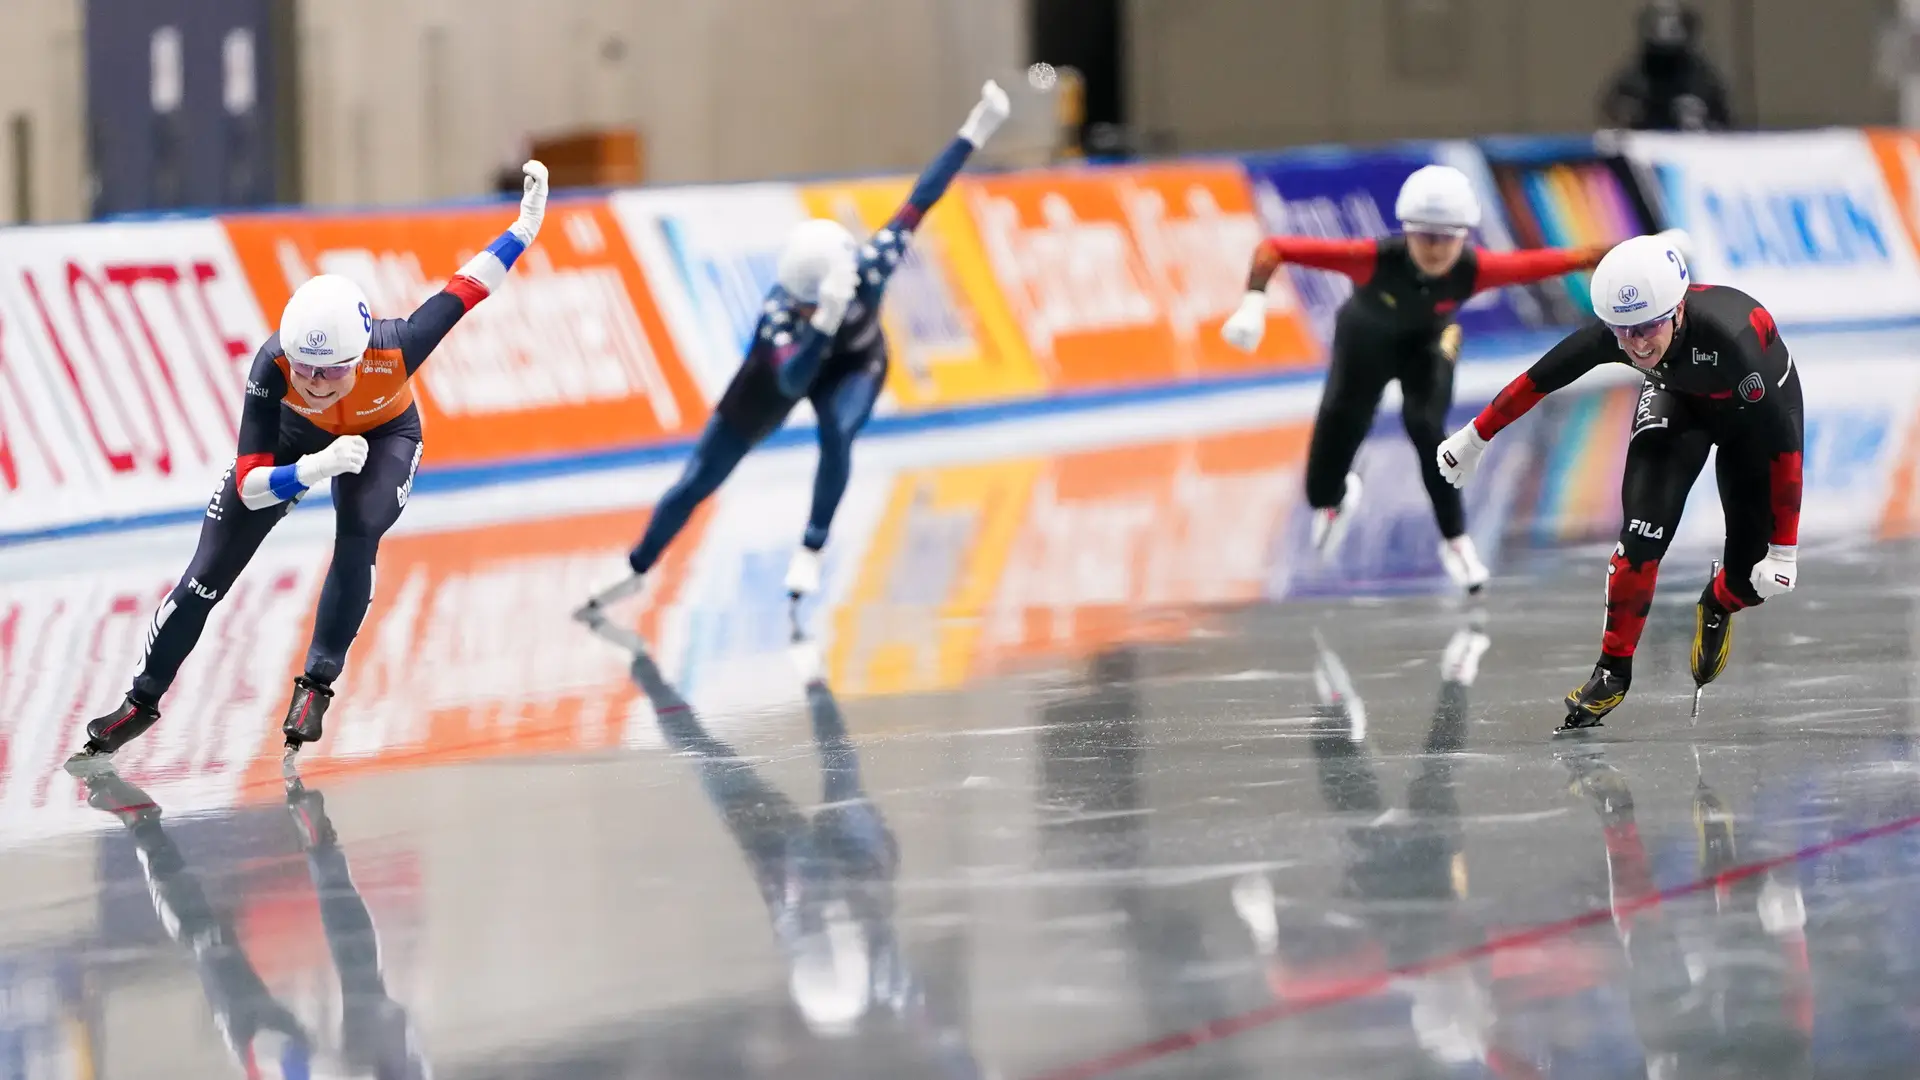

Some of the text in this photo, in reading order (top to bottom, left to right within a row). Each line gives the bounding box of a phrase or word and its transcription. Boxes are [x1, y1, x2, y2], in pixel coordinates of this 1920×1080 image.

[1703, 187, 1890, 267] DAIKIN
[1666, 250, 1687, 280] 2
[357, 301, 372, 333] 8
[22, 261, 252, 476] LOTTE
[1628, 518, 1664, 540] FILA
[187, 577, 218, 600] FILA
